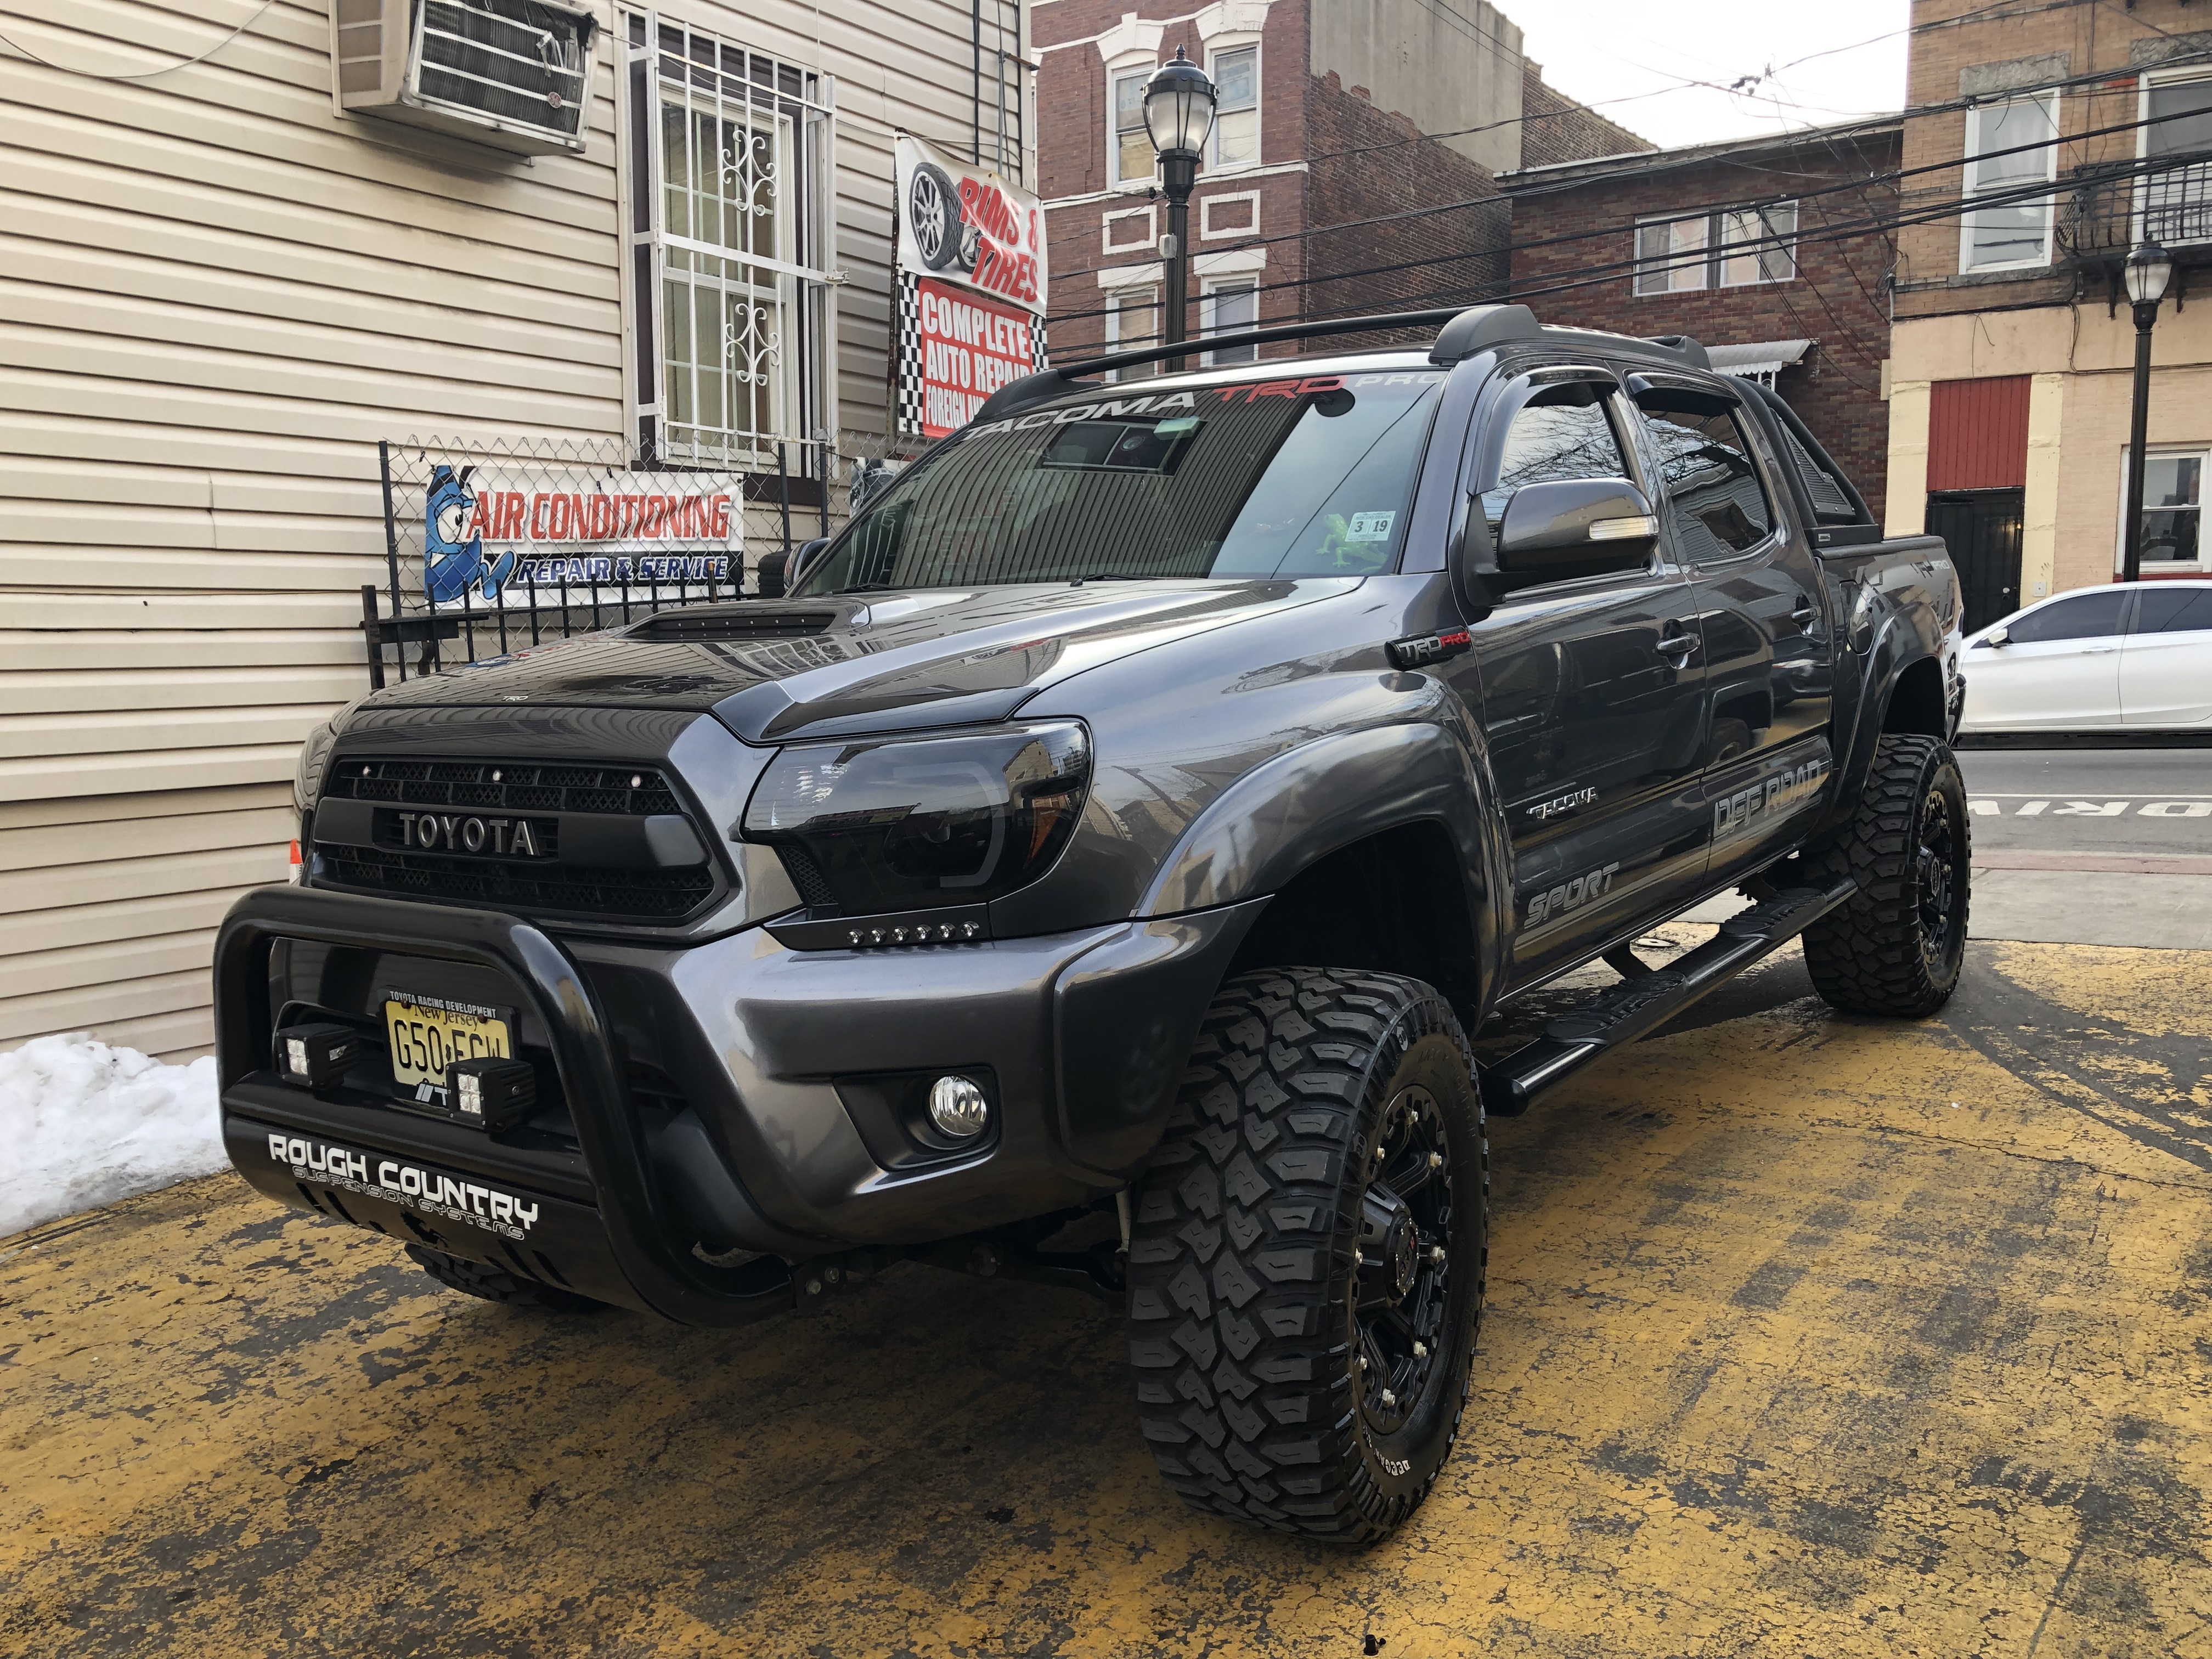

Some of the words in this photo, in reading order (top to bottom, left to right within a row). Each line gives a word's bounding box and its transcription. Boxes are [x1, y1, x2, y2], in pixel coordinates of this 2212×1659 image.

[960, 175, 1022, 247] RIMS
[970, 235, 1039, 303] TIRES
[922, 291, 1029, 360] COMPLETE
[926, 338, 970, 389] AUTO
[926, 383, 967, 430] FOREIGN
[967, 394, 986, 422] AN
[963, 392, 1195, 441] TACOMA
[1213, 376, 1348, 403] TRD
[1354, 373, 1447, 387] PRO
[465, 491, 526, 539] AIR
[530, 494, 731, 539] CONDITIONING
[1354, 521, 1364, 533] 3
[1373, 520, 1388, 532] 19
[517, 558, 612, 583] REPAIR
[615, 557, 635, 582] &
[639, 556, 729, 580] SERVICE
[1398, 636, 1442, 661] TRD
[1439, 631, 1470, 648] PRO
[1713, 782, 1762, 840] OFF
[1764, 759, 1822, 817] ROAD
[399, 812, 540, 856] TOYOTA
[1523, 861, 1620, 929] SPORT
[390, 991, 416, 1004] TOYOTA
[417, 995, 444, 1009] RACING
[445, 1000, 496, 1018] DEVELOPMENT
[414, 1006, 441, 1018] New
[443, 1010, 478, 1031] Jersey
[394, 1019, 444, 1075] G50
[268, 1134, 368, 1183] ROUGH
[379, 1161, 539, 1230] COUNTRY
[292, 1166, 414, 1207] SUSPENSION
[417, 1199, 525, 1240] SYSTEMS
